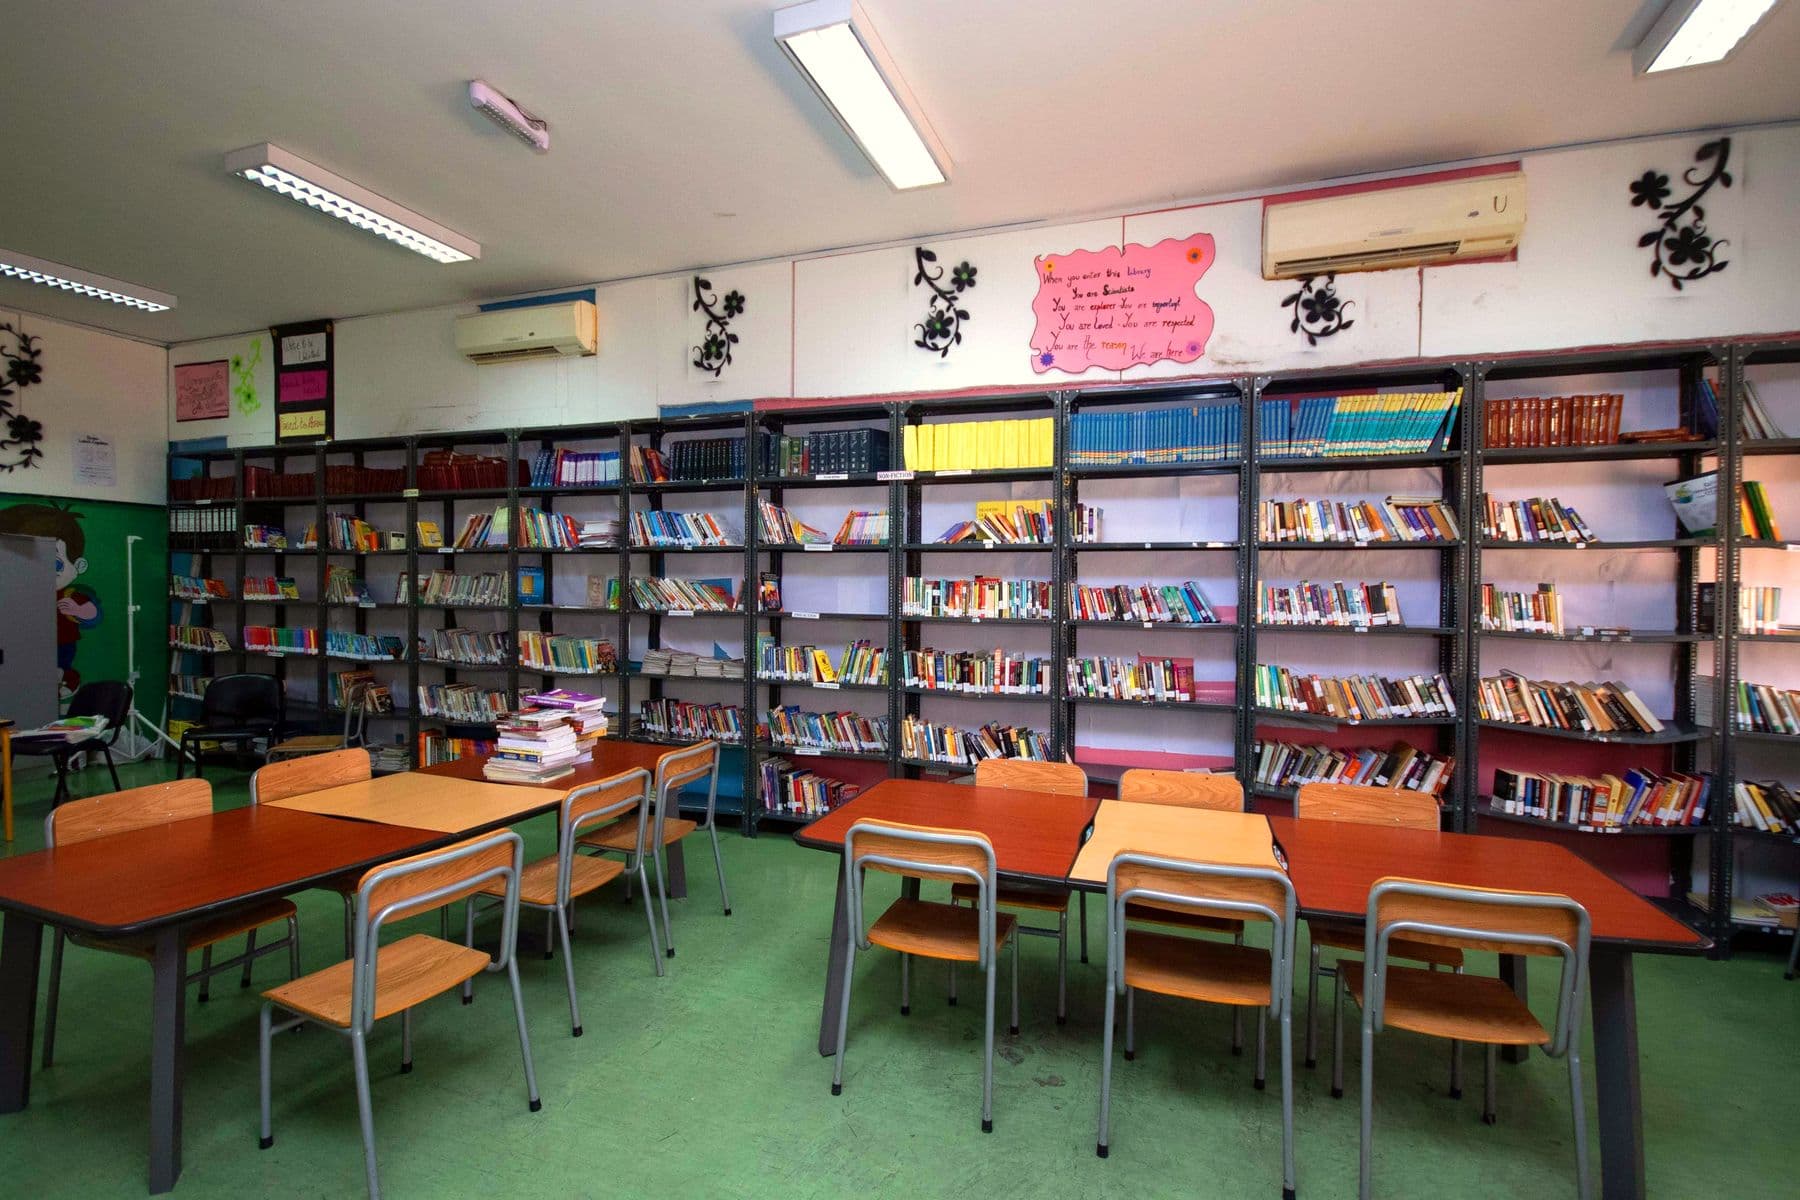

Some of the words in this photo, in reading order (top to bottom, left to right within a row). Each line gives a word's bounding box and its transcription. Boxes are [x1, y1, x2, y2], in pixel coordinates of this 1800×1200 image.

[1043, 271, 1063, 284] When
[1066, 274, 1080, 288] you
[1082, 271, 1101, 280] enter
[1106, 268, 1121, 278] this
[1052, 297, 1066, 312] You
[1058, 312, 1075, 330] You
[1122, 312, 1138, 328] You
[1162, 315, 1195, 333] respected
[1046, 331, 1063, 352] You
[1083, 334, 1097, 361] the
[1101, 341, 1126, 355] reason
[1130, 341, 1146, 361] We
[1150, 351, 1163, 359] are
[1166, 340, 1183, 358] here
